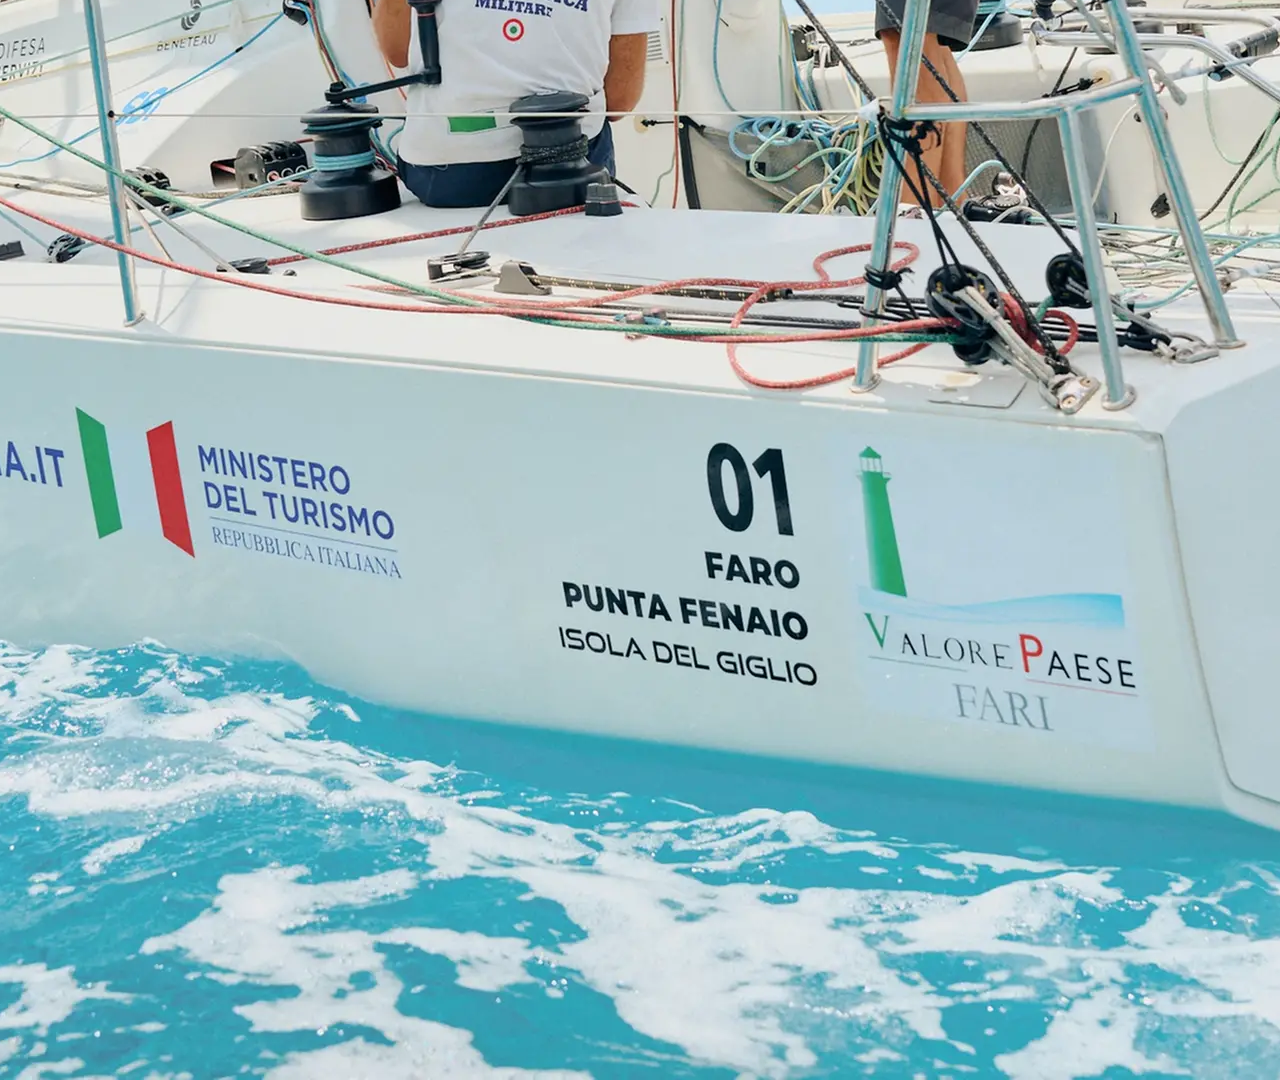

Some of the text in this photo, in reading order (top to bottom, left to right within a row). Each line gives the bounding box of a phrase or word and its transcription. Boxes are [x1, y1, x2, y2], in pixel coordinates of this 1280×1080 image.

[156, 33, 218, 52] BENETEAU
[197, 445, 351, 495] MINISTERO
[706, 442, 794, 536] 01
[204, 481, 395, 540] DEL TURISMO
[212, 526, 403, 580] REPUBBLICA ITALIANA
[704, 551, 800, 589] FARO
[562, 581, 808, 640] PUNTA FENAIO
[558, 626, 817, 686] ISOLA DEL GIGLIO
[951, 683, 1055, 731] FARI
